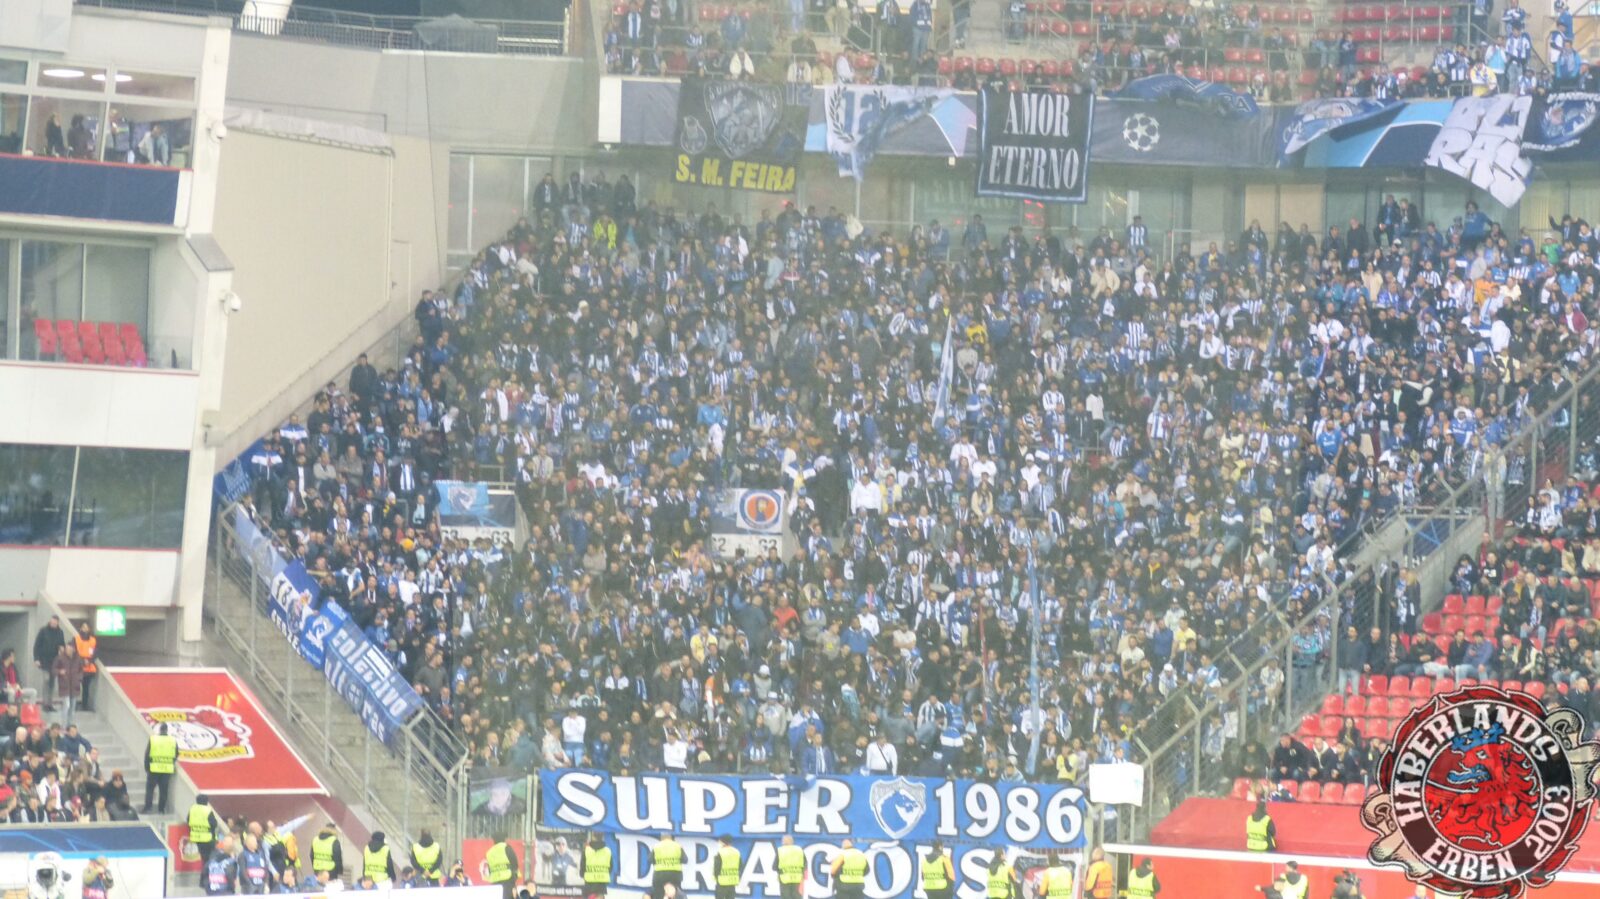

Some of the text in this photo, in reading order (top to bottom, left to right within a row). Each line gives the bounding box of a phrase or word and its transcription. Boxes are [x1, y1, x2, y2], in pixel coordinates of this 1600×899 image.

[1003, 91, 1070, 137] AMOR
[676, 154, 796, 192] S. M. FEIRA
[989, 145, 1080, 190] ETERNO
[556, 772, 1084, 844] SUPER 1986
